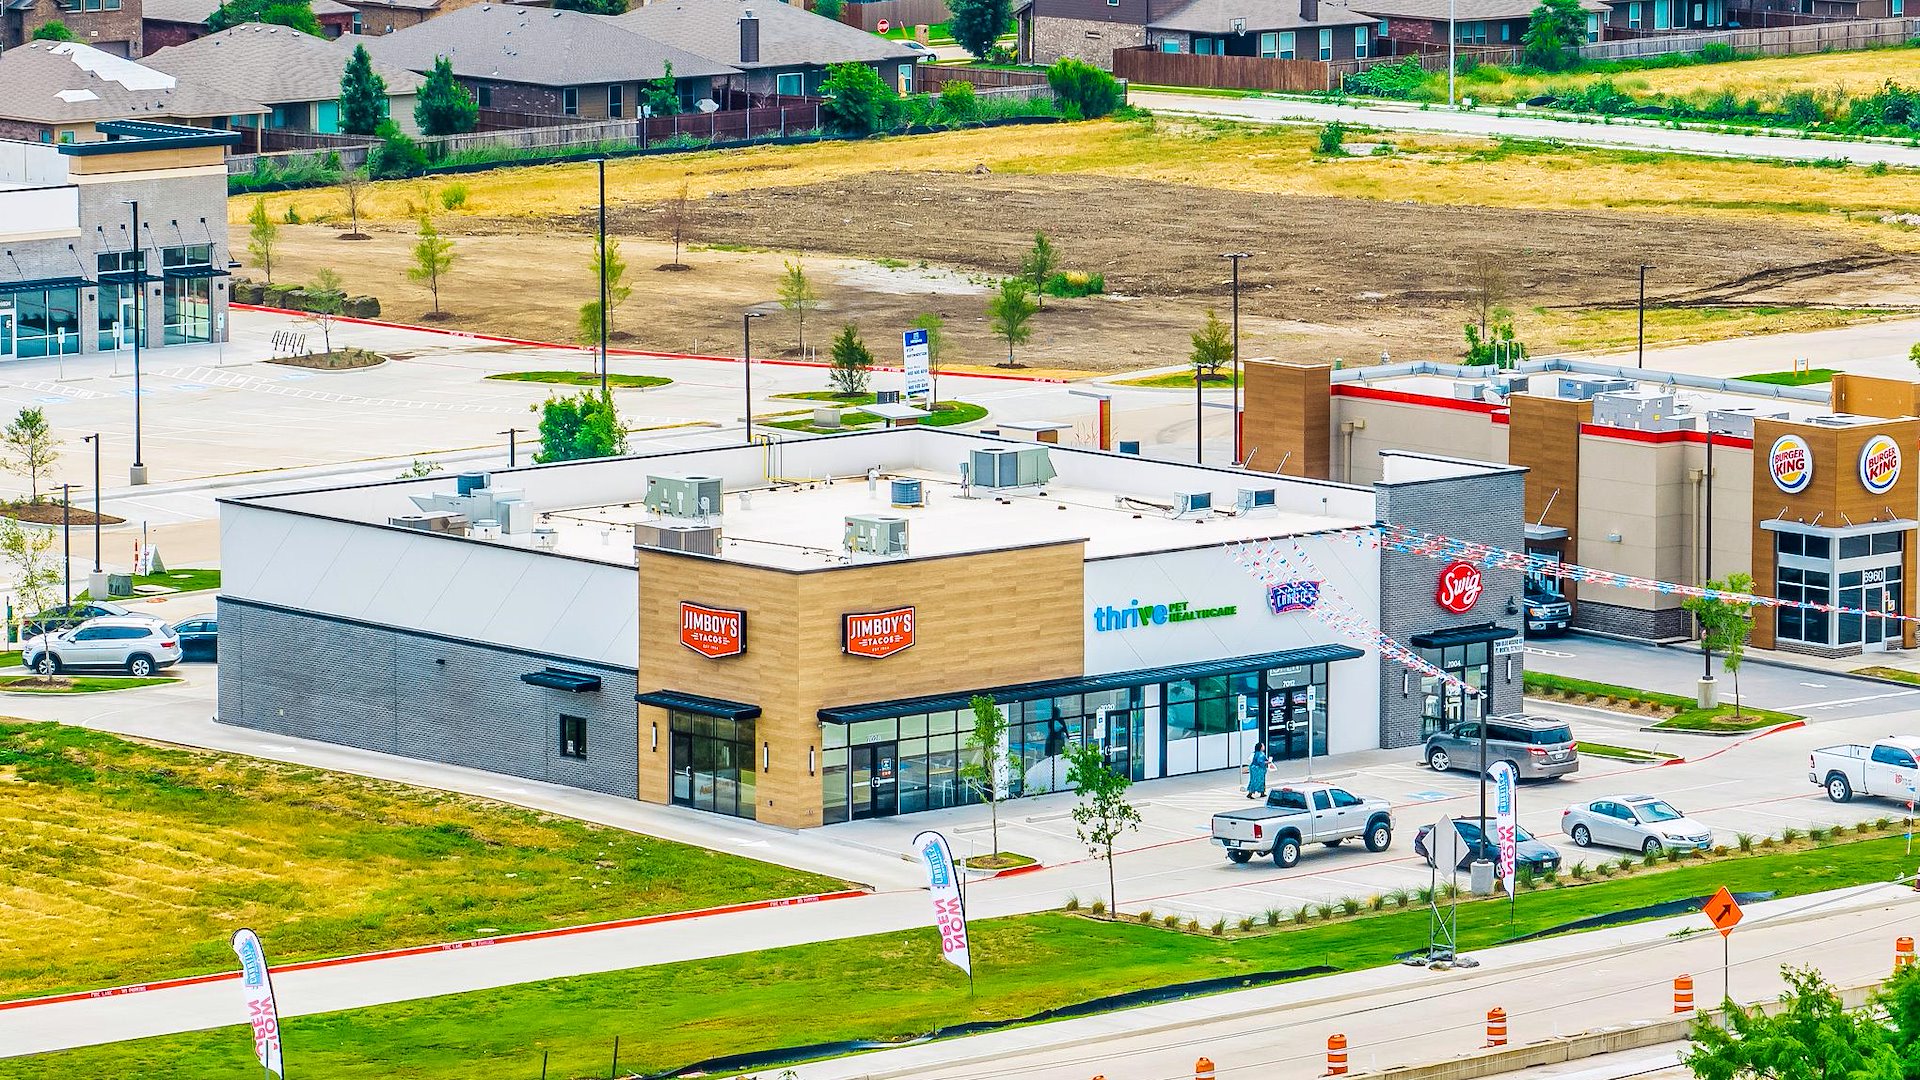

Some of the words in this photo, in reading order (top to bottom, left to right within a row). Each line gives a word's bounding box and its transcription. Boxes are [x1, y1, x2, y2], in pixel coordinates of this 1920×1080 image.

[1775, 449, 1804, 463] BURGER
[1869, 447, 1896, 468] BURGER
[1775, 458, 1805, 477] KING
[1869, 456, 1897, 481] KING
[1864, 570, 1884, 583] 6960
[1441, 571, 1482, 605] Swig
[1094, 599, 1168, 632] thrive
[1169, 602, 1189, 612] PET
[1169, 606, 1237, 622] HEALTHCARE
[683, 610, 738, 638] JIMBOY'S
[850, 613, 912, 640] JIMBOY'S
[699, 633, 723, 645] TACOS
[868, 635, 895, 646] TACOS
